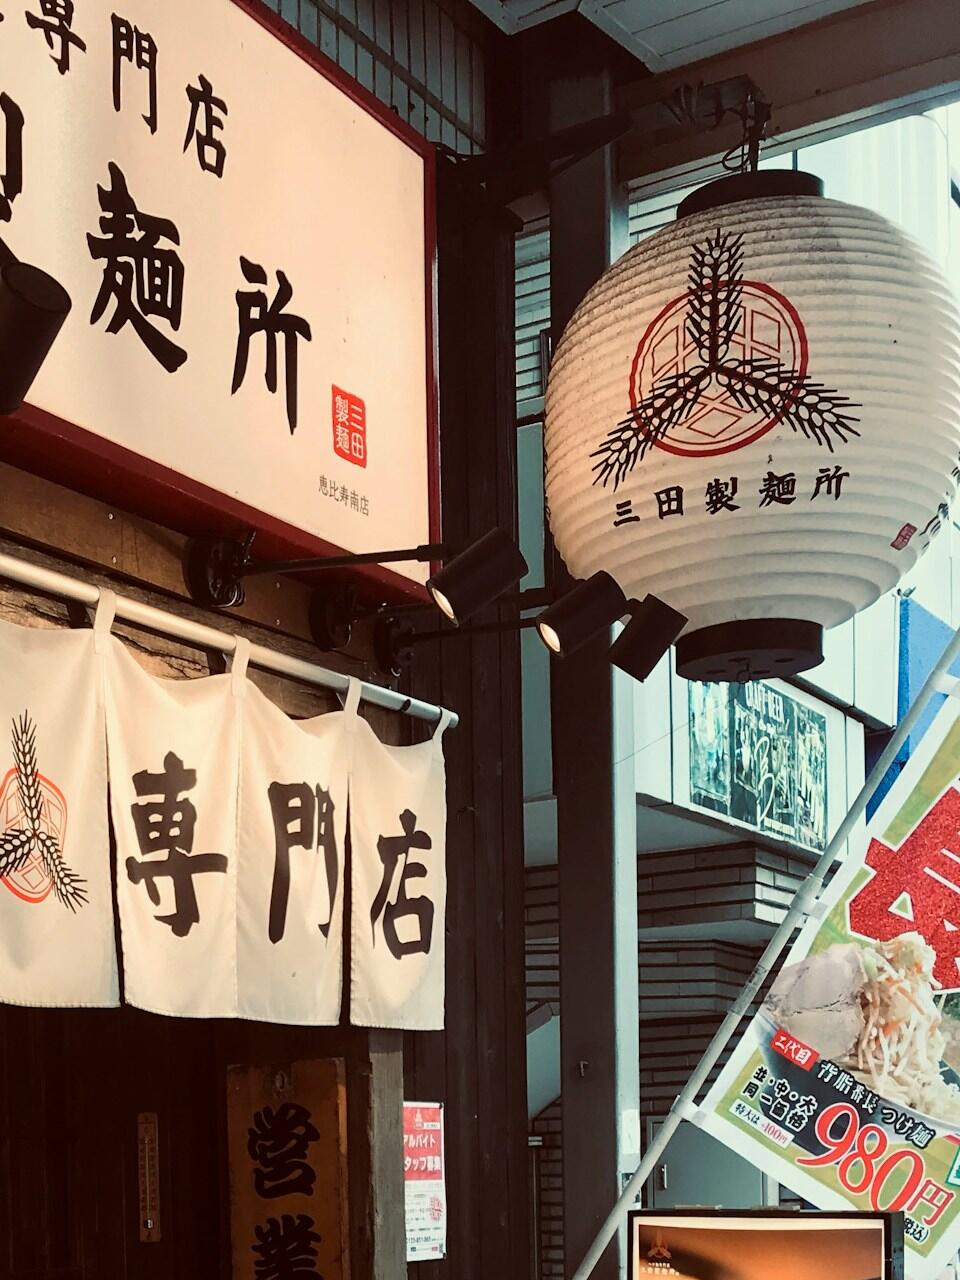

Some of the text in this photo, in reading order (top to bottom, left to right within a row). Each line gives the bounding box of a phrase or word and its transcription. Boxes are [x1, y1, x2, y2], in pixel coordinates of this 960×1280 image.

[318, 474, 369, 516] 恵比寿南店
[611, 463, 852, 528] 三田製麺所
[124, 748, 440, 962] 専門店
[816, 1061, 935, 1149] 背脂番長 つけ麺
